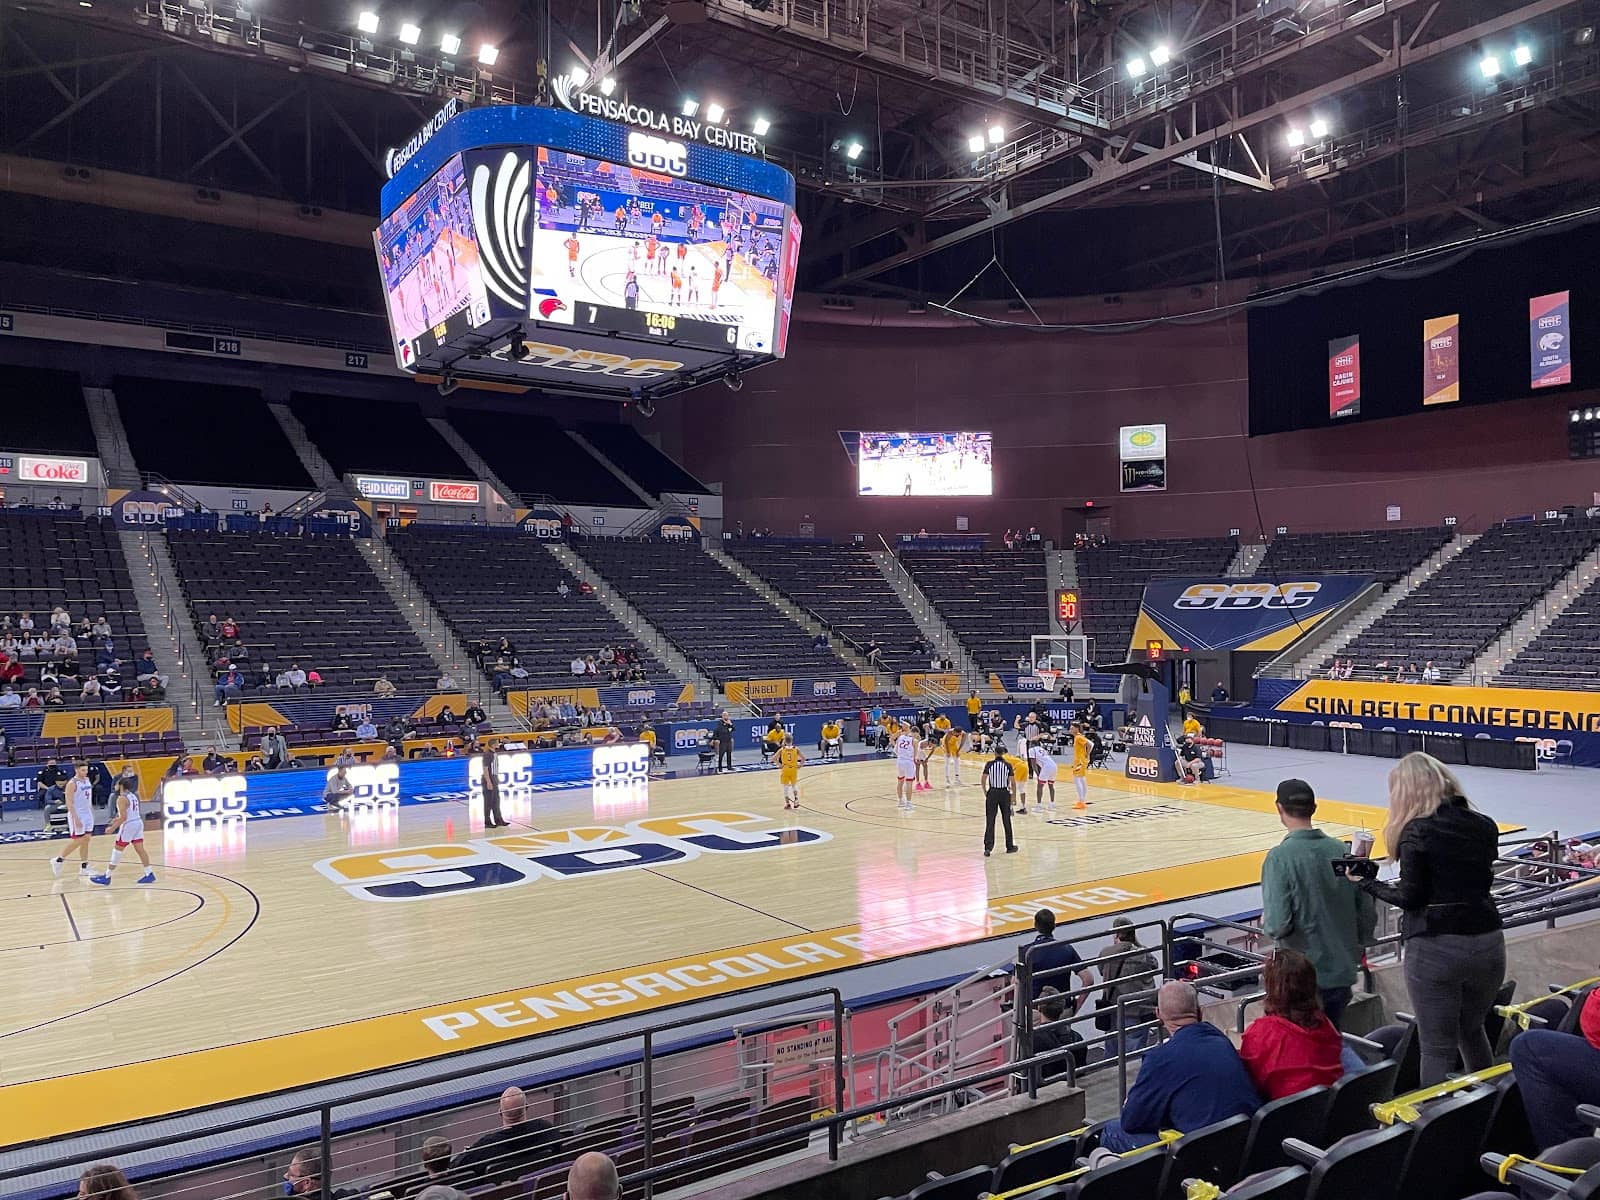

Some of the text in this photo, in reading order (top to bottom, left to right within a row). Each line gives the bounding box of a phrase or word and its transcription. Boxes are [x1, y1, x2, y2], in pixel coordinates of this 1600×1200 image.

[580, 92, 758, 155] PENSACOLA BAY CENTER
[393, 97, 457, 173] PENSACOLA BAY CENTER
[588, 306, 597, 323] 7
[646, 312, 676, 330] 16:06
[726, 327, 737, 344] 6
[33, 463, 79, 479] Coke
[383, 484, 406, 494] LIGHT
[1445, 517, 1457, 525] 122
[1545, 511, 1557, 519] 123
[1173, 582, 1321, 609] SBC
[1060, 603, 1075, 618] 30
[1151, 649, 1159, 658] 30
[744, 683, 778, 695] SUN BELT
[813, 681, 836, 696] SBC
[628, 690, 656, 706] SBC
[1305, 696, 1353, 716] SUN
[77, 716, 141, 730] SUN BELT
[1134, 727, 1155, 736] FIRST
[1134, 734, 1155, 743] BANK
[900, 740, 910, 749] 22
[786, 753, 792, 762] 3
[1128, 756, 1159, 778] SBC
[2, 778, 38, 795] BEL
[314, 811, 834, 902] SBC
[422, 940, 847, 1041] PENSACOLA
[776, 1047, 785, 1055] NO
[787, 1040, 813, 1053] STANDING
[823, 1035, 834, 1044] RAIL
